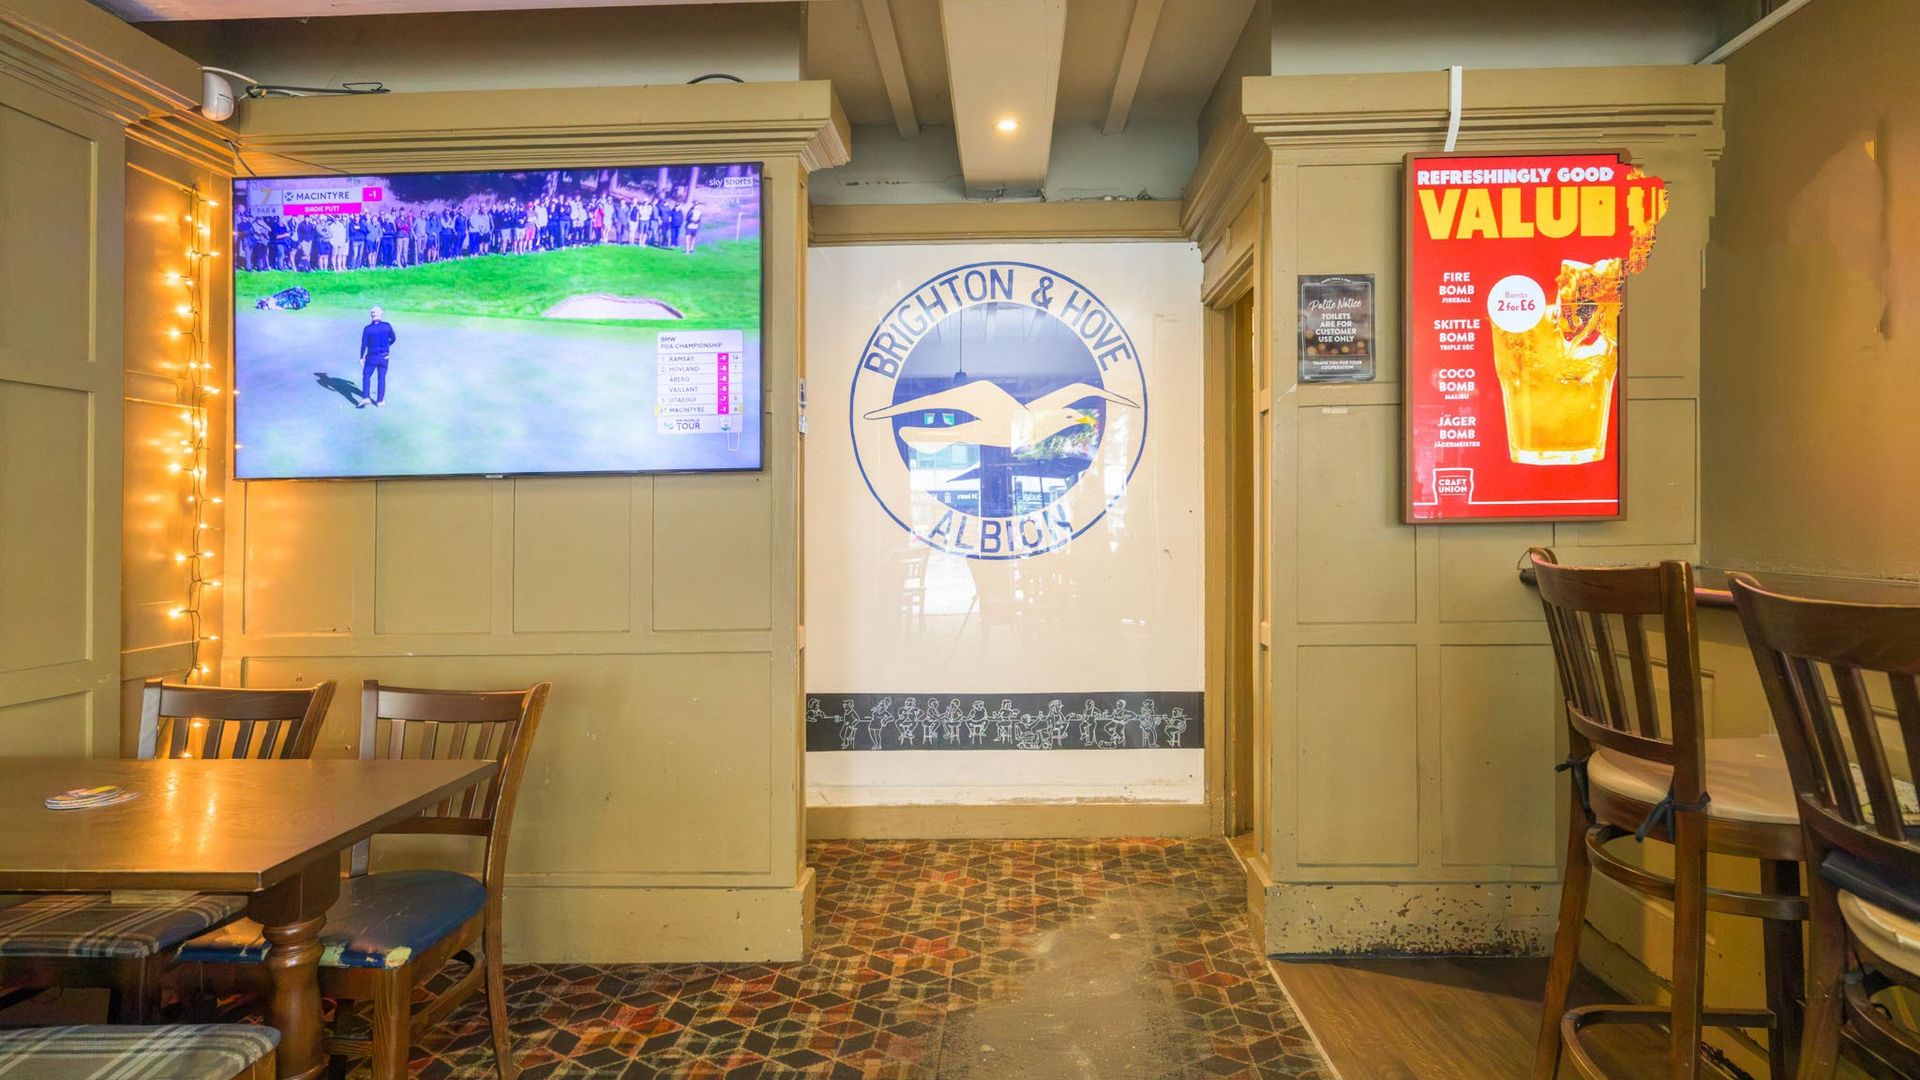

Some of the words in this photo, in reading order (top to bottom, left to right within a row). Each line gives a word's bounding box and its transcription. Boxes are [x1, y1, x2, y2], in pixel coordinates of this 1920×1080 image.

[1417, 167, 1552, 186] REFRESHINGLY
[1557, 166, 1615, 183] GOOD
[260, 187, 273, 205] 7
[296, 191, 350, 201] MACINTYRE
[1443, 272, 1471, 283] FIRE
[1439, 285, 1475, 296] BOMB
[1309, 299, 1336, 311] Polite
[1337, 297, 1362, 310] Notice
[1497, 300, 1505, 311] 2
[1506, 302, 1519, 311] for
[1520, 300, 1536, 311] £6
[864, 268, 1014, 379] BRIGHTON
[1031, 276, 1054, 310] &
[1061, 289, 1132, 372] HOVE
[1336, 320, 1352, 328] FOR
[1434, 319, 1480, 330] SKITTLE
[1334, 335, 1355, 343] ONLY
[1439, 332, 1475, 343] BOMB
[1439, 368, 1476, 379] COCO
[1439, 381, 1475, 392] BOMB
[676, 422, 701, 430] TOUR
[1437, 414, 1477, 427] JÄGER
[1439, 429, 1475, 440] BOMB
[1434, 440, 1480, 448] JÄGERMEISTER
[1438, 478, 1467, 486] CRAFT
[1438, 485, 1467, 493] UNION
